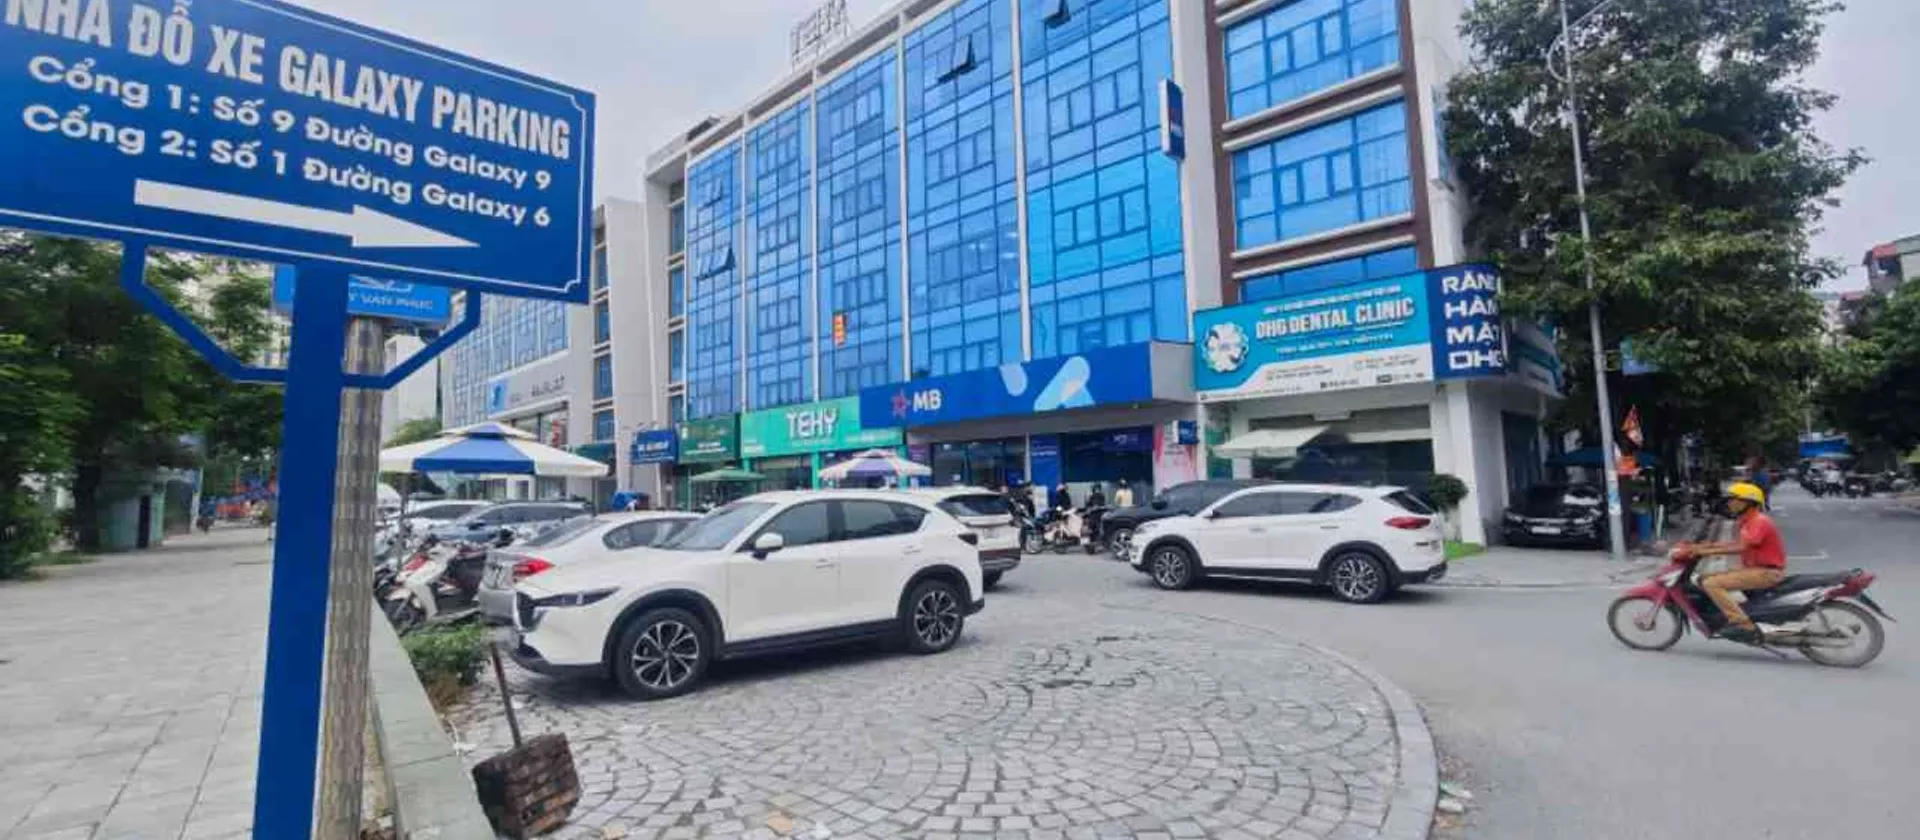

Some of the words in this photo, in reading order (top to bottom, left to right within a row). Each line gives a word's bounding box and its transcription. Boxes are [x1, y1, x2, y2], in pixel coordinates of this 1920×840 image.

[128, 0, 194, 66] ĐỖ
[206, 24, 266, 85] XE
[279, 44, 425, 123] GALAXY
[431, 84, 571, 160] PARKING
[28, 56, 149, 109] Cổng
[167, 84, 201, 115] 1:
[213, 95, 265, 127] Số
[271, 109, 296, 133] 9
[304, 115, 414, 167] Đường
[423, 145, 528, 190] Galaxy
[534, 169, 552, 192] 9
[22, 104, 146, 156] Cổng
[159, 129, 197, 158] 2:
[209, 138, 262, 169] Số
[271, 150, 288, 176] 1
[302, 156, 413, 205] Đường
[421, 183, 528, 226] Galaxy
[532, 206, 552, 227] 6
[1288, 308, 1352, 335] DENTAL
[1355, 297, 1415, 325] CLINIC
[785, 407, 837, 438] TEHY
[912, 388, 942, 412] MB
